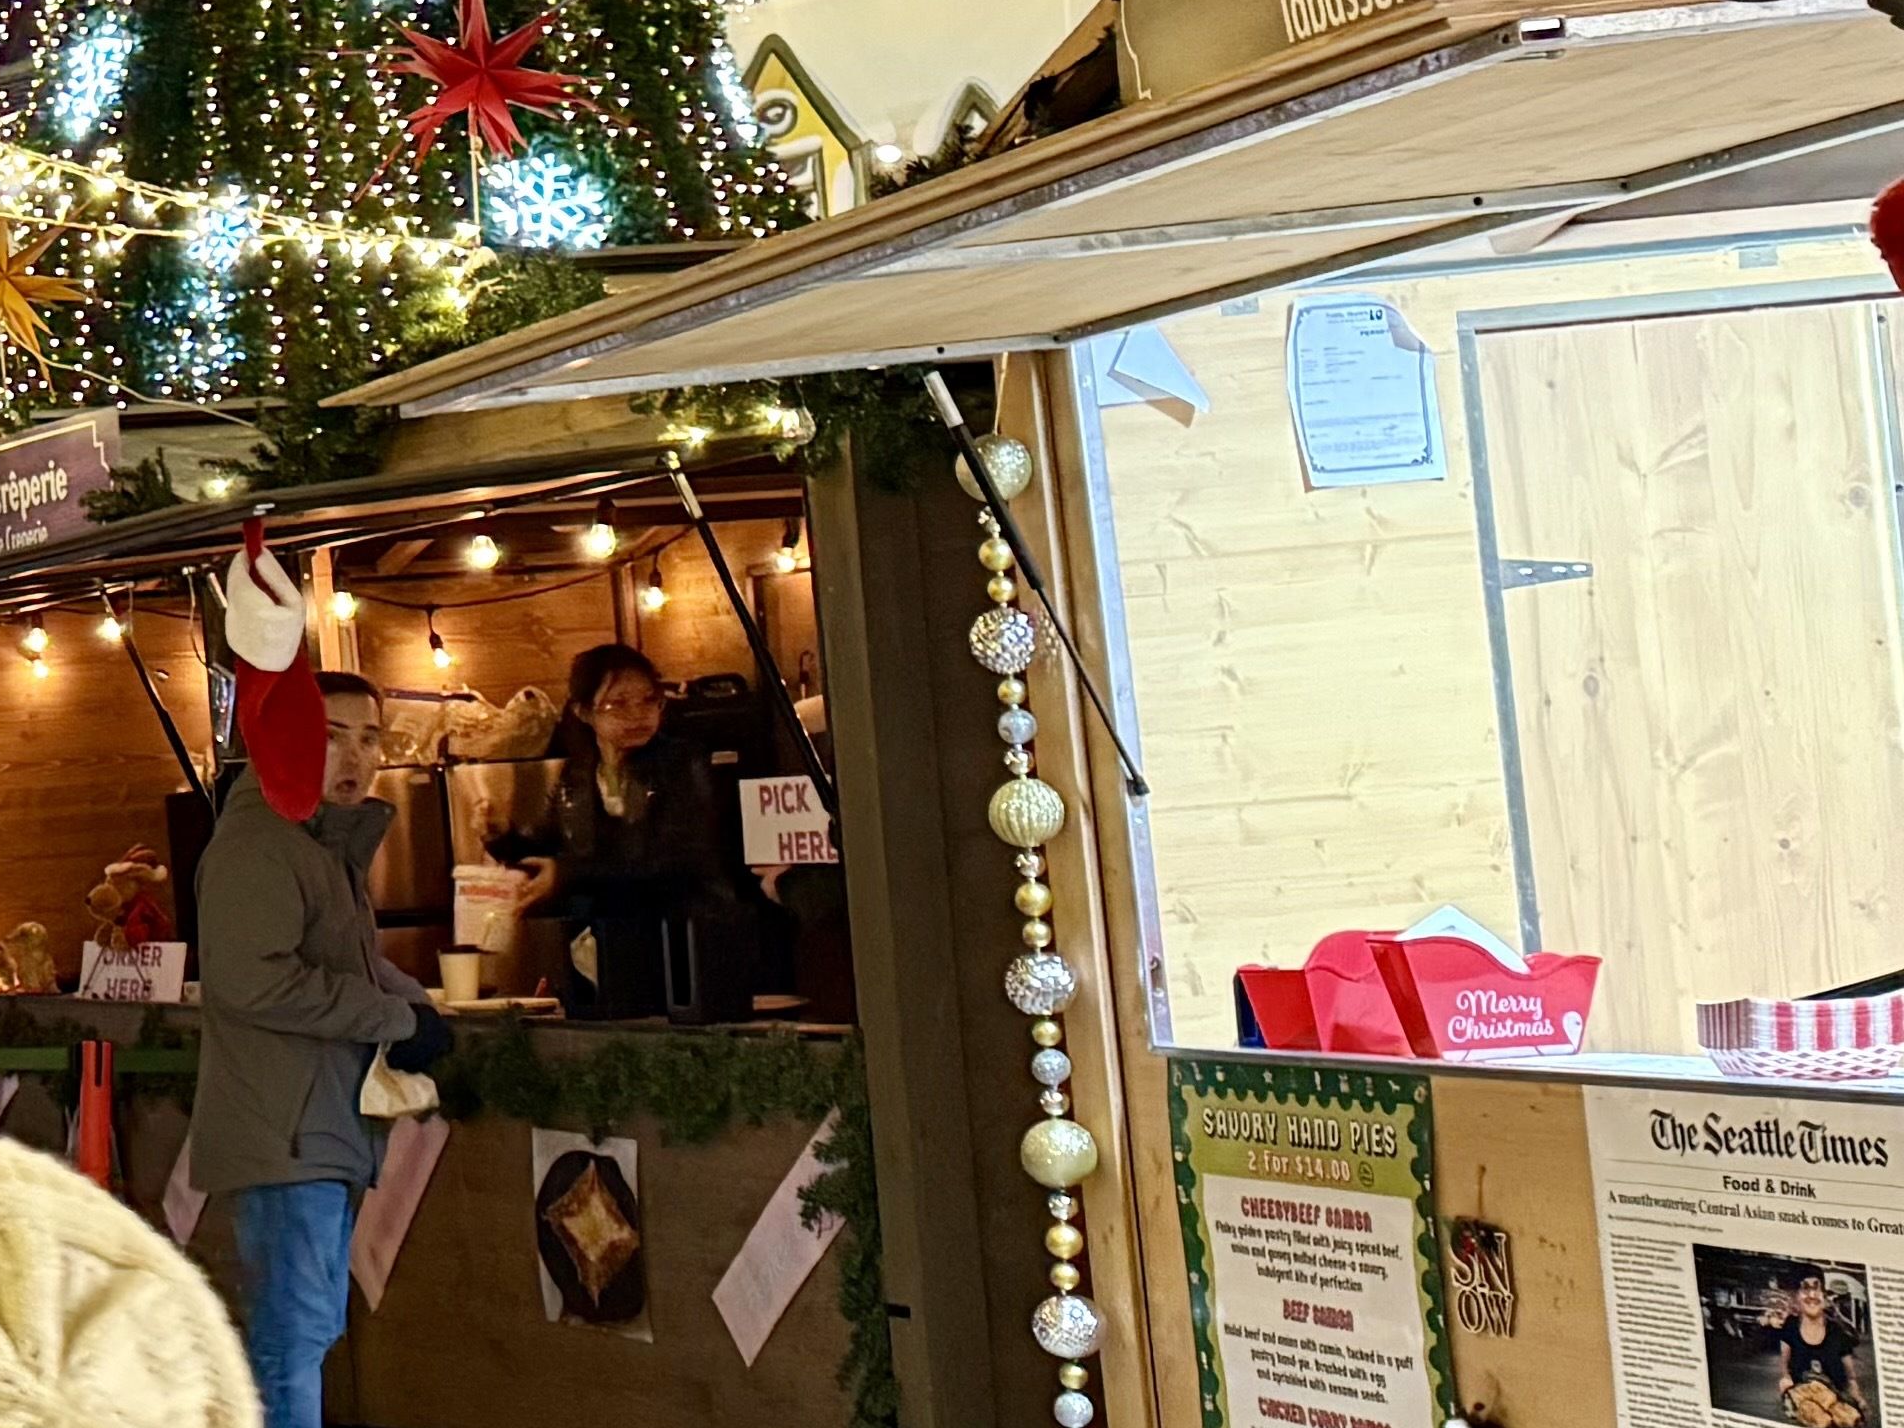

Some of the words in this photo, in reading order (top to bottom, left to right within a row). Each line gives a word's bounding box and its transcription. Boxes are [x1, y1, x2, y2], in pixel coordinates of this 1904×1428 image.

[758, 782, 811, 815] PICK
[1456, 989, 1543, 1021] Merry
[1447, 1015, 1555, 1043] Christmas
[1203, 1107, 1278, 1146] SAVORY
[1287, 1115, 1342, 1150] HAND
[1349, 1121, 1398, 1157] PIES
[1650, 1108, 1699, 1157] The
[1703, 1111, 1797, 1157] Seattle
[1796, 1119, 1889, 1168] Times
[1248, 1150, 1256, 1170] 2
[1263, 1150, 1288, 1174] For
[1295, 1154, 1351, 1181] $14.00
[1722, 1175, 1760, 1193] Food
[1765, 1179, 1776, 1194] &
[1780, 1180, 1817, 1199] Drink
[1608, 1190, 1617, 1204] A
[1617, 1193, 1697, 1214] mouthwatering
[1698, 1199, 1741, 1218] Central
[1743, 1204, 1776, 1221] Asian
[1778, 1210, 1809, 1225] snack
[1811, 1215, 1850, 1229] comes
[1851, 1218, 1865, 1231] to
